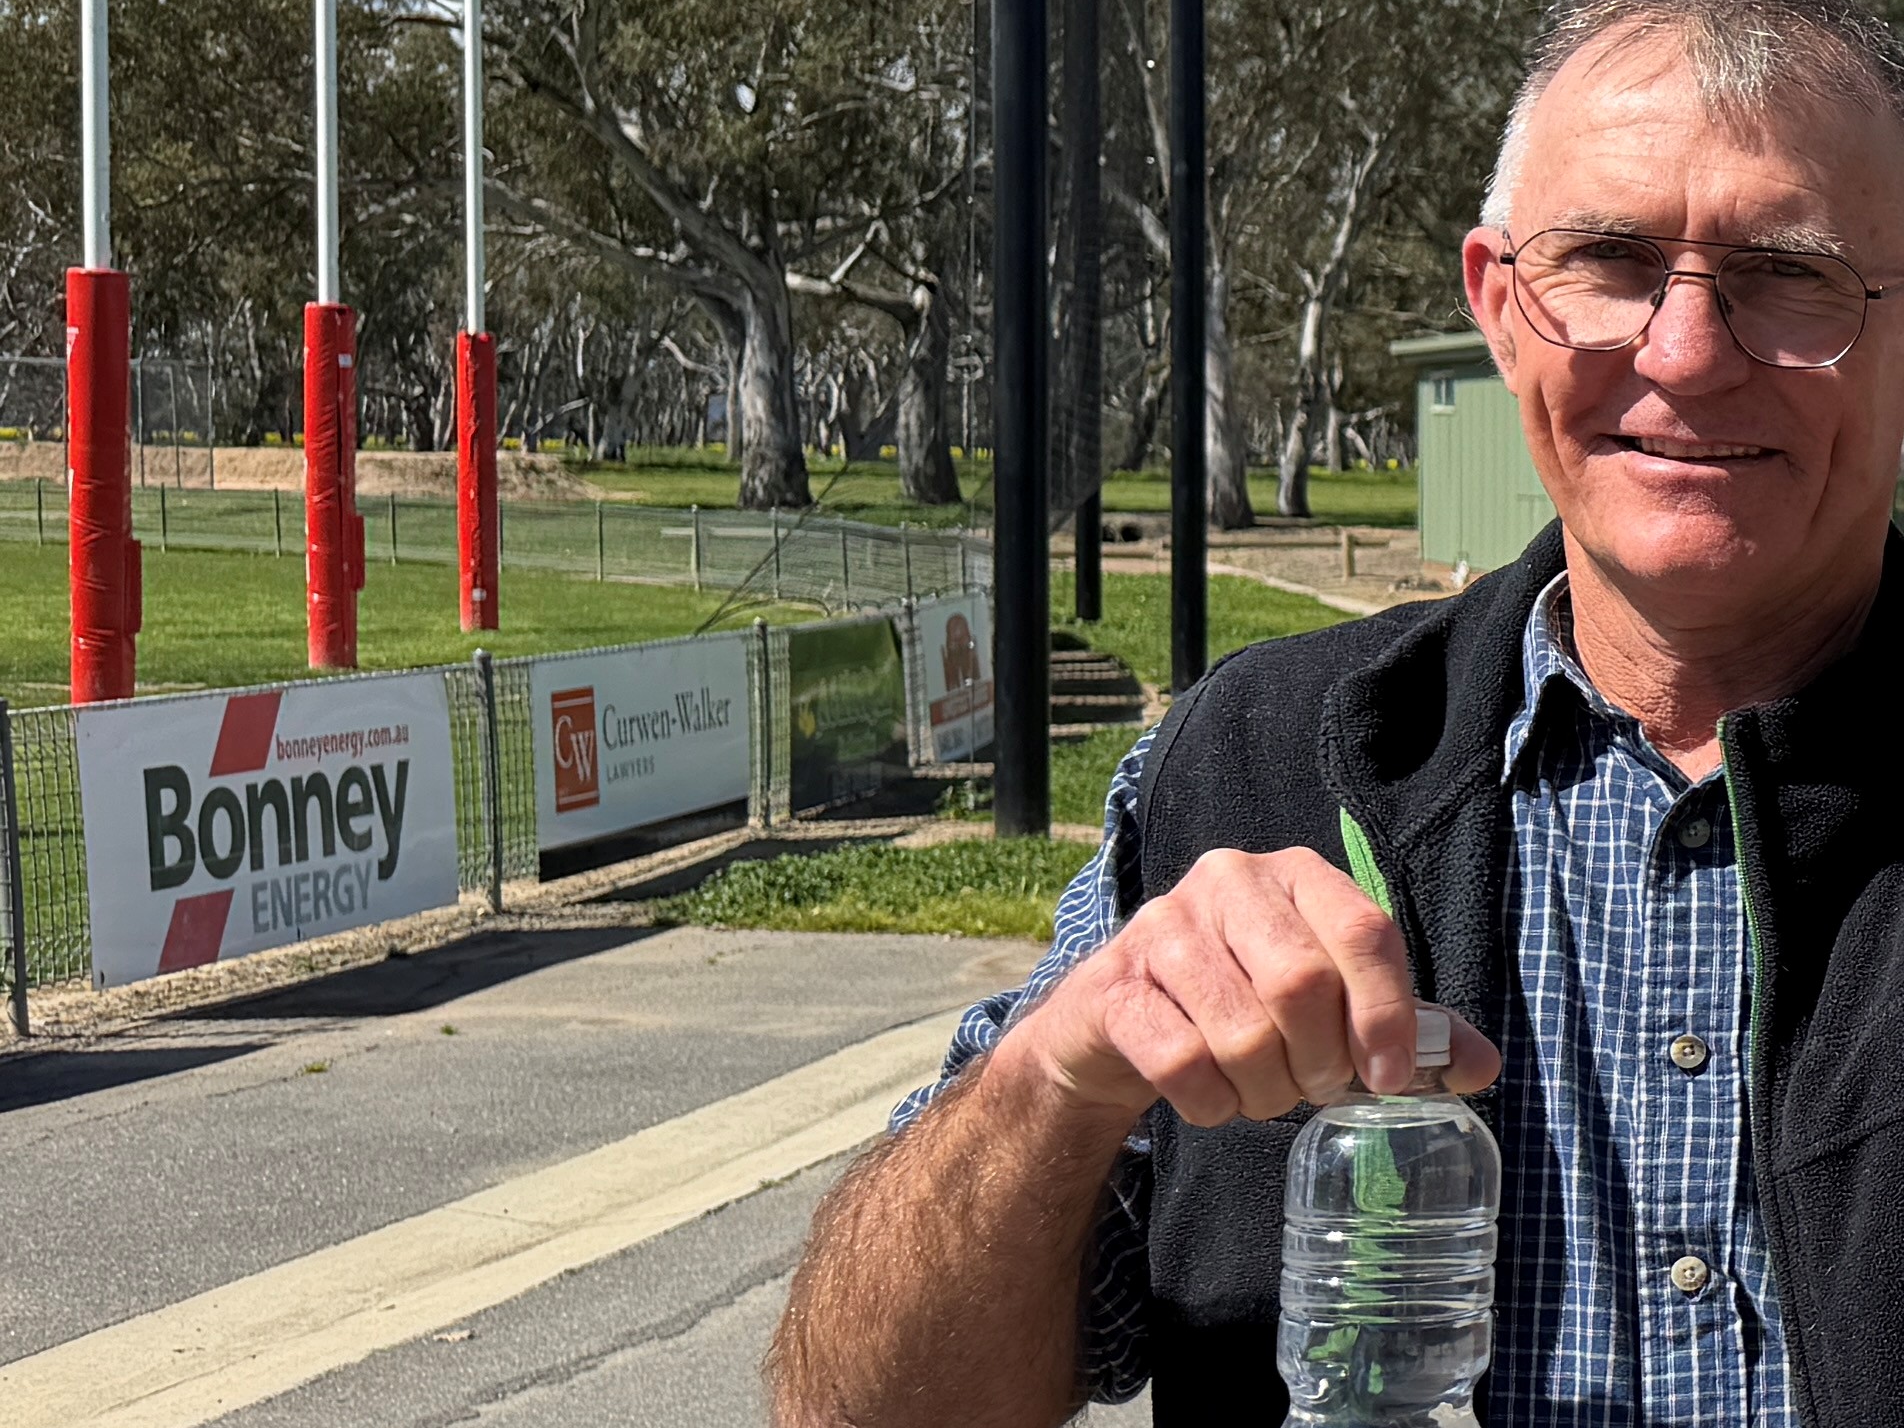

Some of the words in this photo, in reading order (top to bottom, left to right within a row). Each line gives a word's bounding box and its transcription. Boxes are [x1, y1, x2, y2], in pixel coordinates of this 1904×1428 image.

[275, 724, 410, 762] bonneyenergy.com.au
[602, 687, 731, 751] Curwen-Walker
[606, 755, 655, 784] LAWYERS
[143, 758, 410, 892] Bonney
[251, 863, 373, 933] ENERGY
